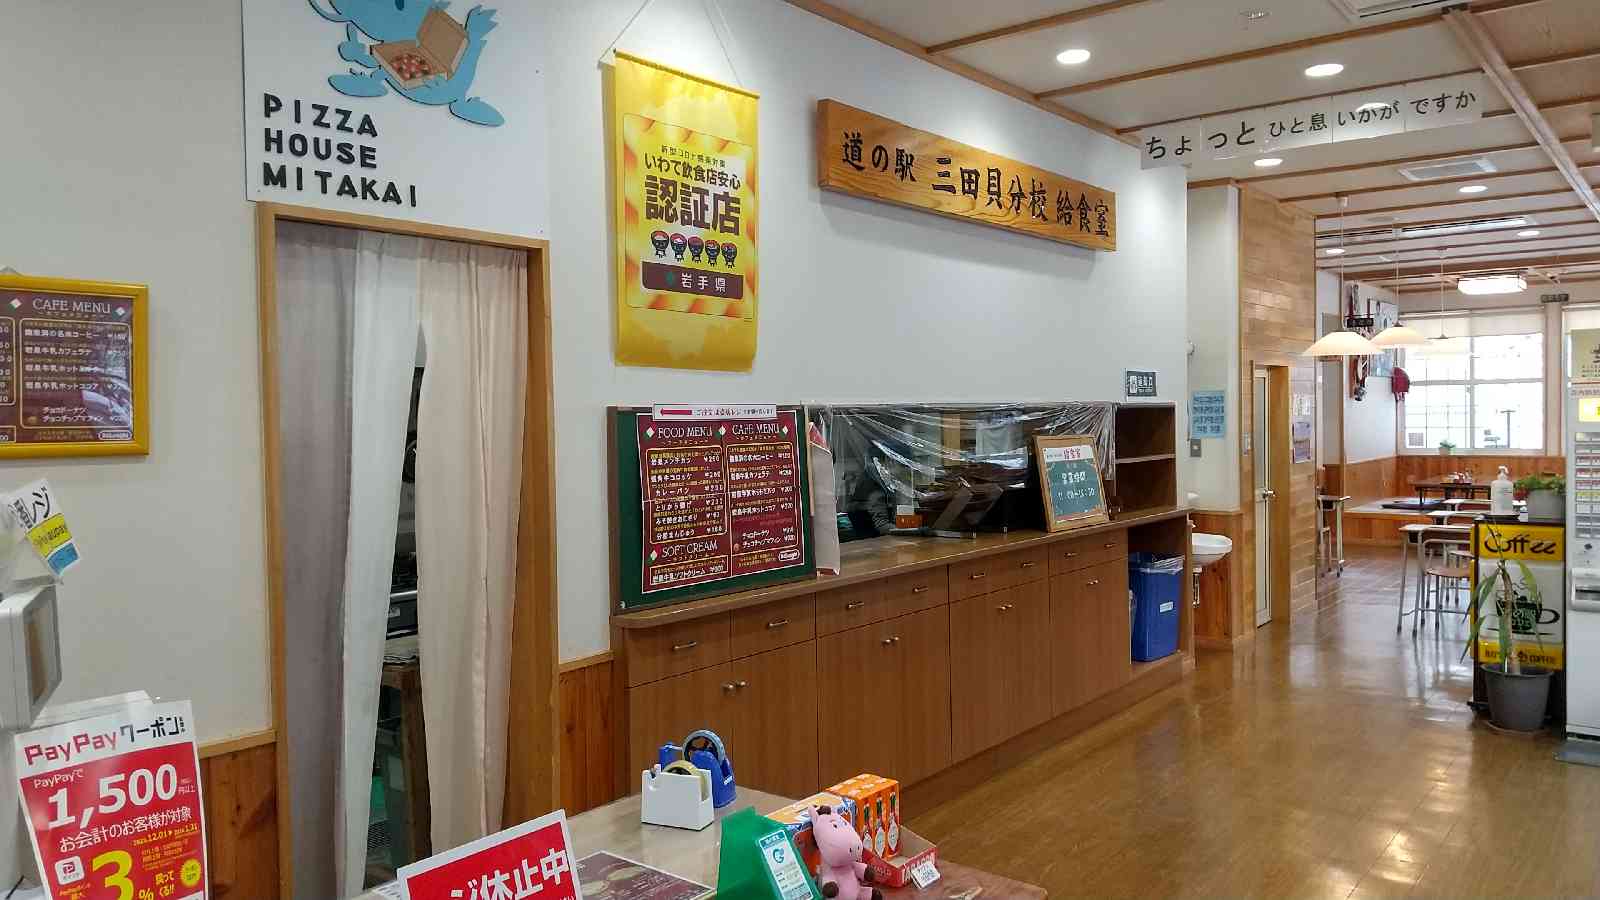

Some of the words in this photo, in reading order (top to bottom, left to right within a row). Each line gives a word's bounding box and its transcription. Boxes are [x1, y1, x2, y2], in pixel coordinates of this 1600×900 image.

[264, 92, 378, 138] PIZZA
[1146, 121, 1256, 160] ちょっと
[1268, 112, 1328, 137] ひと息
[1337, 99, 1399, 127] いかが
[1409, 90, 1477, 116] ですか
[264, 127, 378, 169] HOUSE
[262, 162, 417, 207] MITAKAI
[644, 152, 741, 191] いわて飲食店安心
[842, 129, 917, 183] 道の駅
[932, 157, 1048, 223] 三田貝分校
[1056, 189, 1110, 238] 給食室
[644, 174, 741, 237] 認証店
[681, 272, 727, 293] 岩手県
[33, 298, 68, 311] CAFE
[72, 301, 111, 314] MENU
[658, 427, 685, 439] FOOD
[687, 426, 713, 437] MENU
[731, 424, 754, 435] CAFE
[756, 423, 780, 434] MENU
[655, 487, 690, 497] カレーパン
[662, 544, 685, 558] SOFT
[686, 539, 718, 555] CREAM
[1484, 531, 1557, 556] Coffee
[33, 768, 84, 789] PayPayで
[48, 763, 178, 829] 1,500
[59, 807, 193, 853] お会計のお客様が対象
[92, 850, 135, 900] 3
